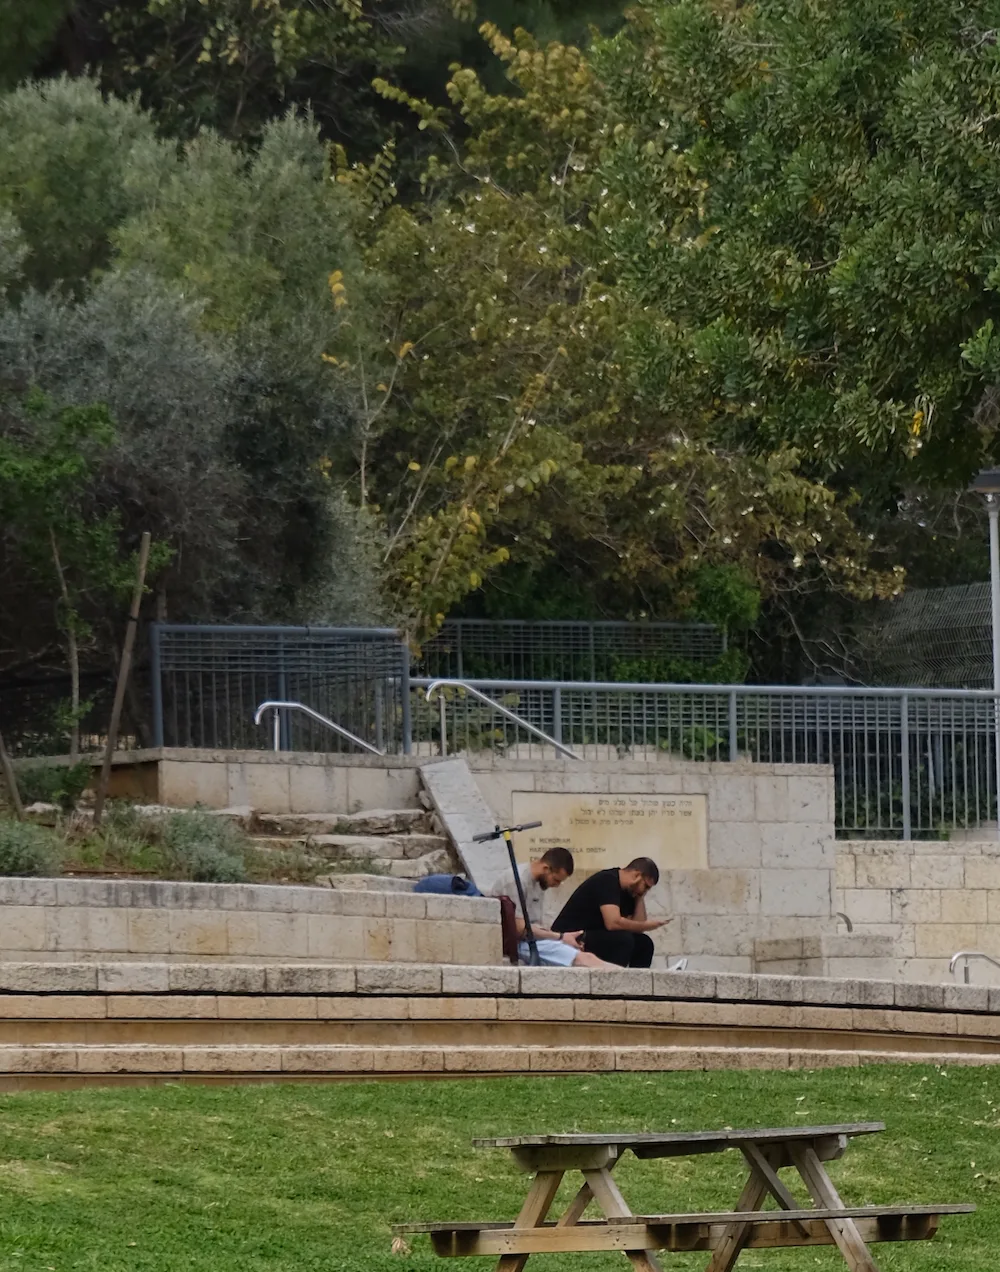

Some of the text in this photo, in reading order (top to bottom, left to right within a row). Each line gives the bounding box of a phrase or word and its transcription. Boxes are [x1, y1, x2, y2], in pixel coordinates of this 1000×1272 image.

[596, 808, 606, 816] לא
[648, 809, 658, 818] יתן
[678, 809, 693, 817] אשר
